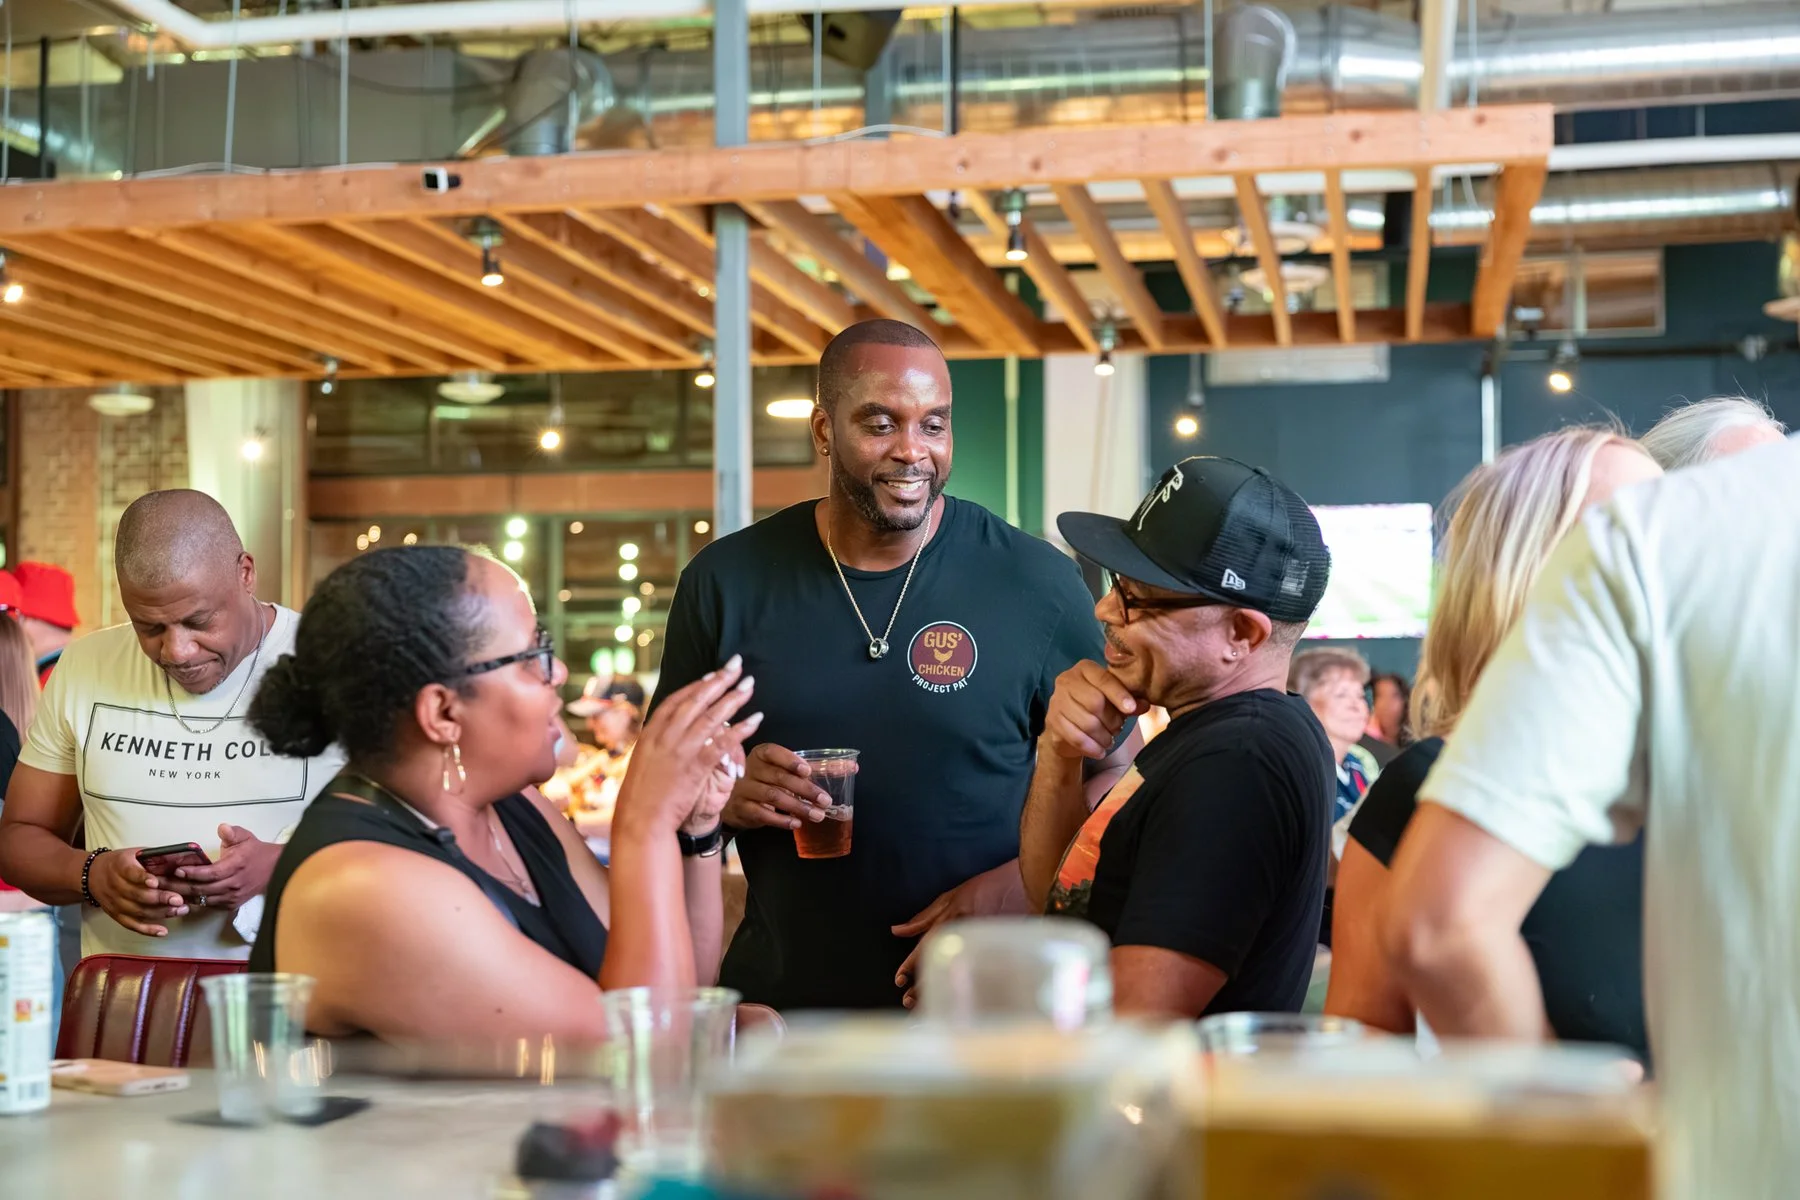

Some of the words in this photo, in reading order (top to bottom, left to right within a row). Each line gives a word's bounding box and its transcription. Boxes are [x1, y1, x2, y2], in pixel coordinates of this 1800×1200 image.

[924, 631, 962, 649] GUS'
[918, 664, 965, 677] CHICKEN
[912, 674, 951, 693] PROJECT
[952, 678, 968, 691] PAT
[100, 732, 212, 761] KENNETH
[225, 740, 271, 760] COL
[148, 768, 178, 779] NEW
[186, 771, 221, 780] YORK
